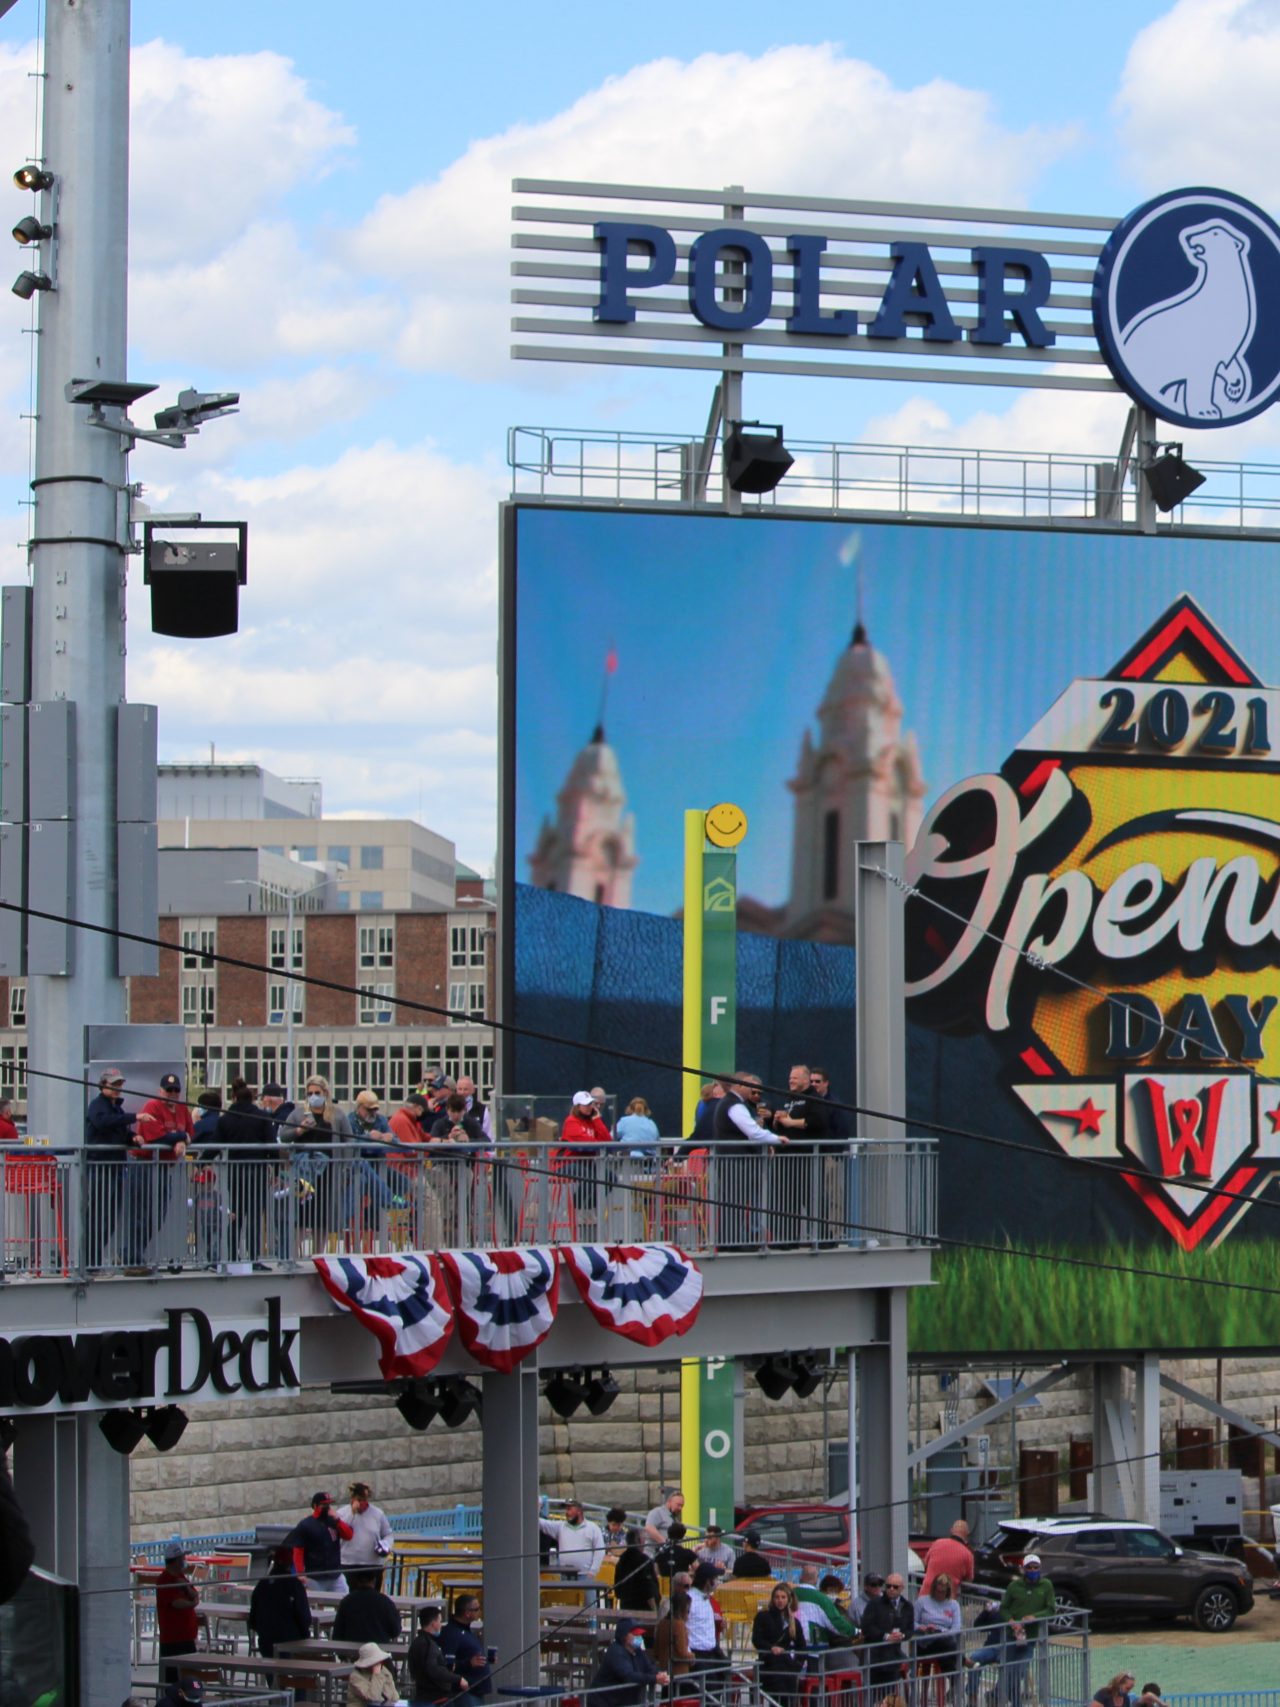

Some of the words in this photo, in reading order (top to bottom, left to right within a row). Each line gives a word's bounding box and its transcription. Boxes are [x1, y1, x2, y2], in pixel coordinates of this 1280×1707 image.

[593, 221, 1056, 347] POLAR
[1100, 687, 1272, 755] 2021
[1105, 992, 1279, 1060] DAY
[1145, 1077, 1229, 1181] W
